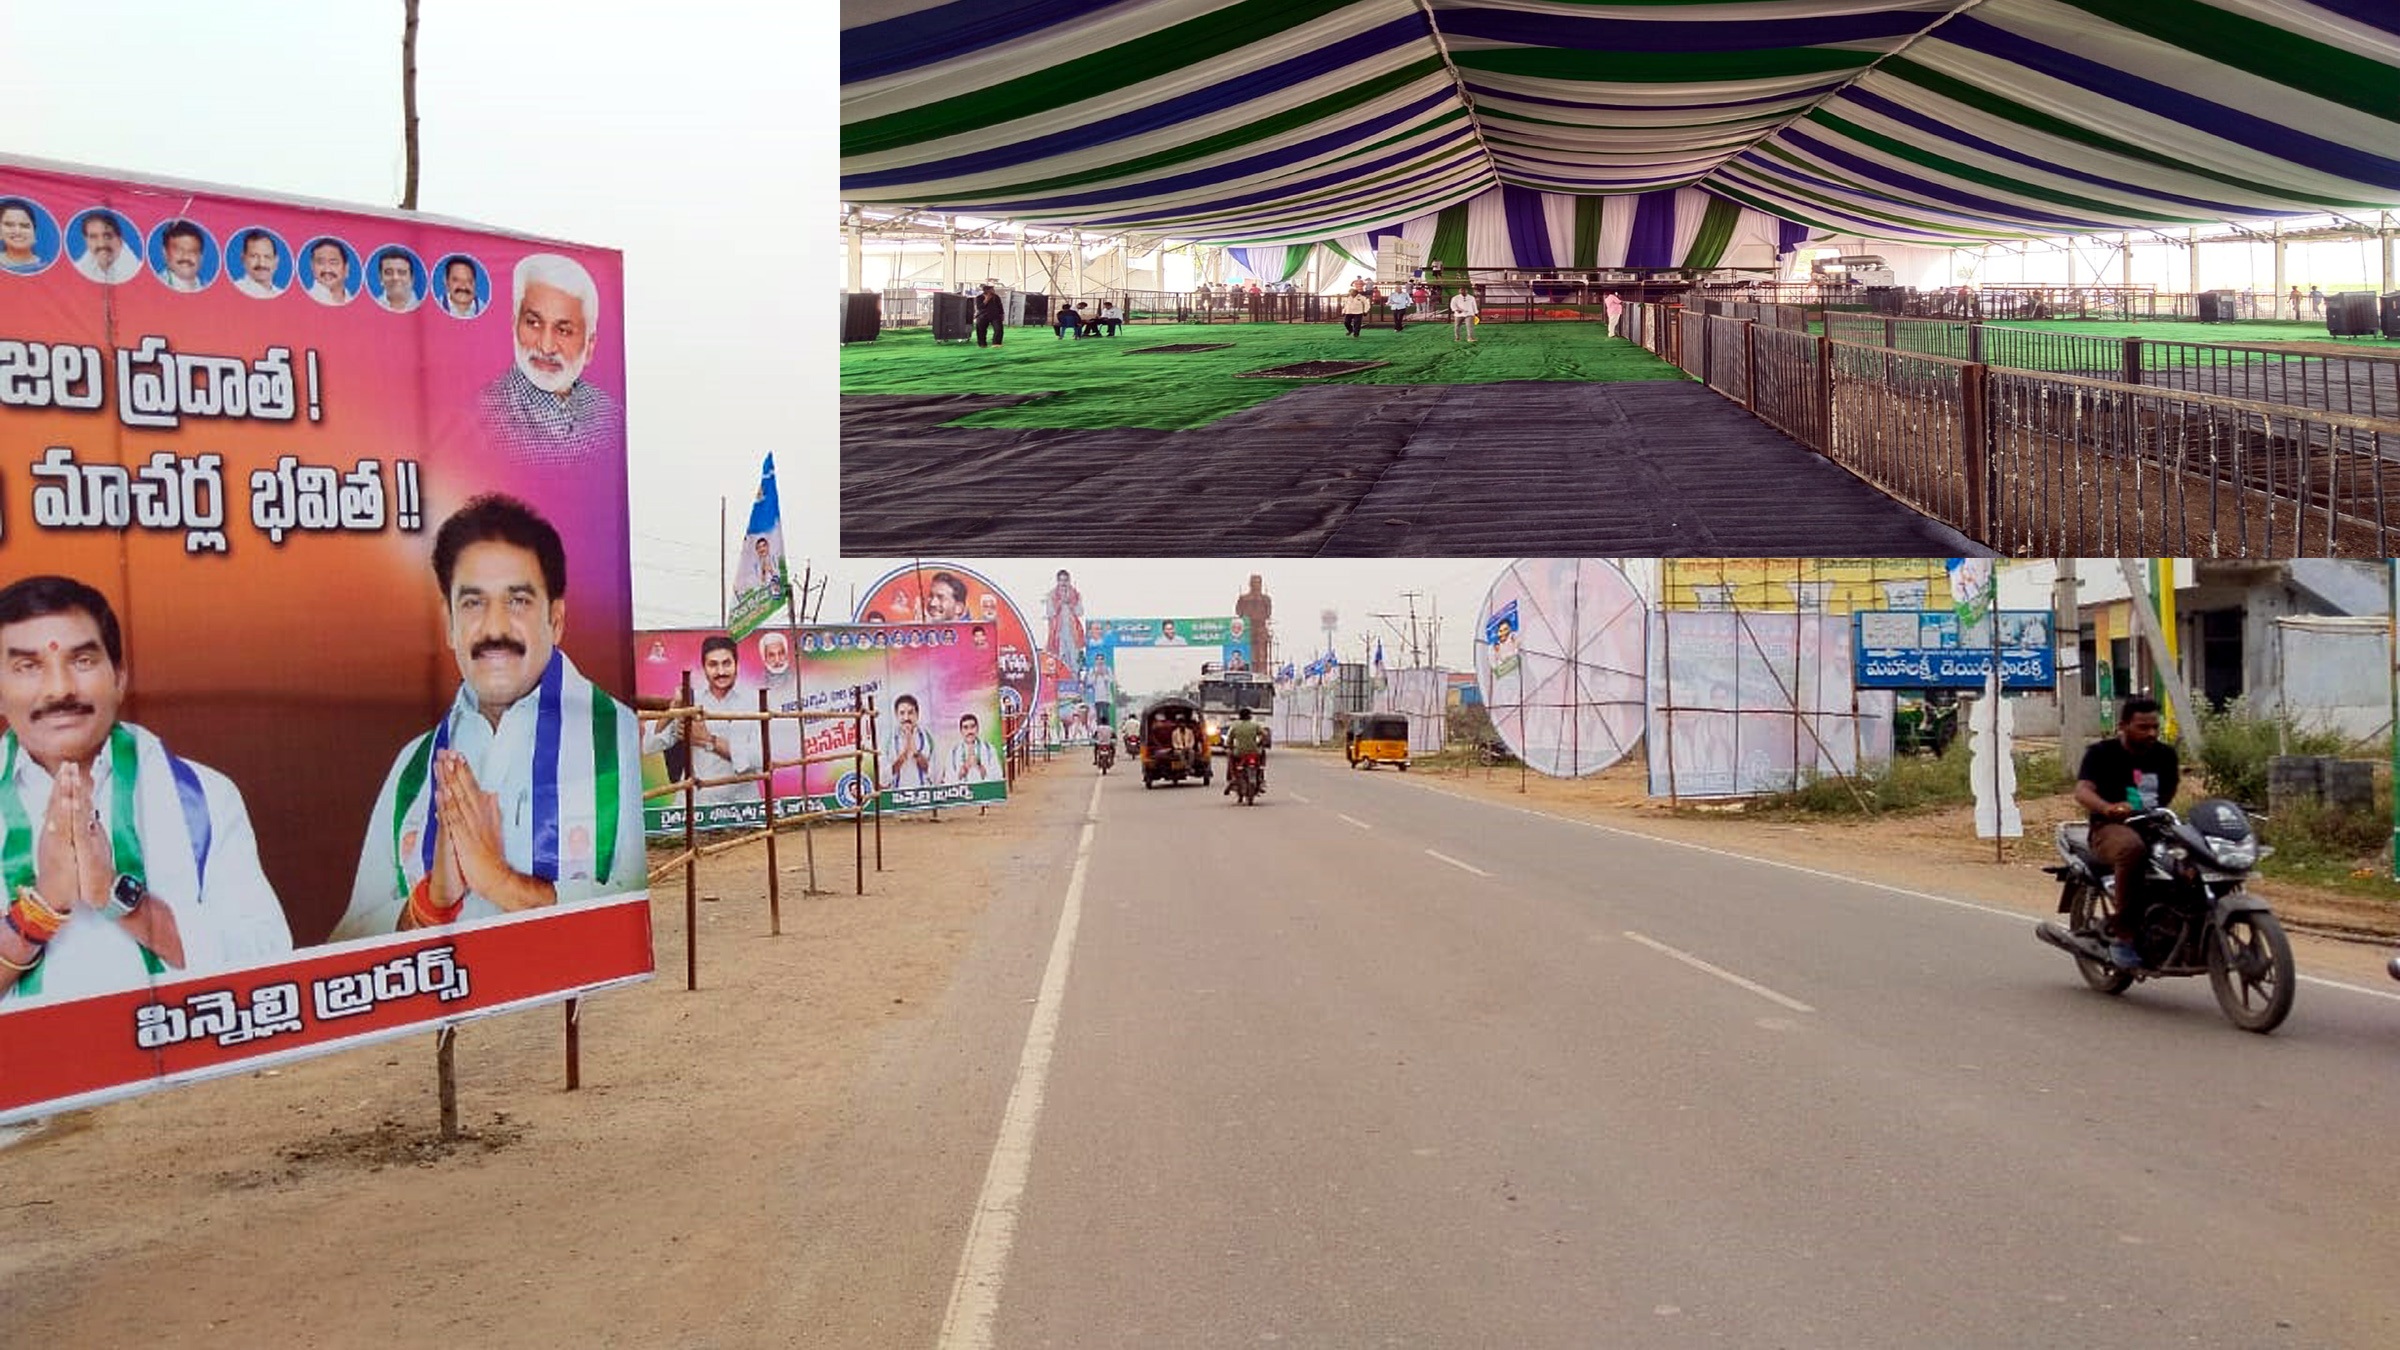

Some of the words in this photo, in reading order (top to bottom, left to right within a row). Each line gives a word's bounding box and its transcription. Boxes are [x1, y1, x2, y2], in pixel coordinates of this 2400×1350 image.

[116, 334, 295, 427] ప్రదాత
[31, 447, 228, 553] మాచర్ల
[250, 455, 386, 544] భవిత
[136, 982, 303, 1049] పిన్నెల్లి
[313, 946, 469, 1021] బ్రదర్స్
